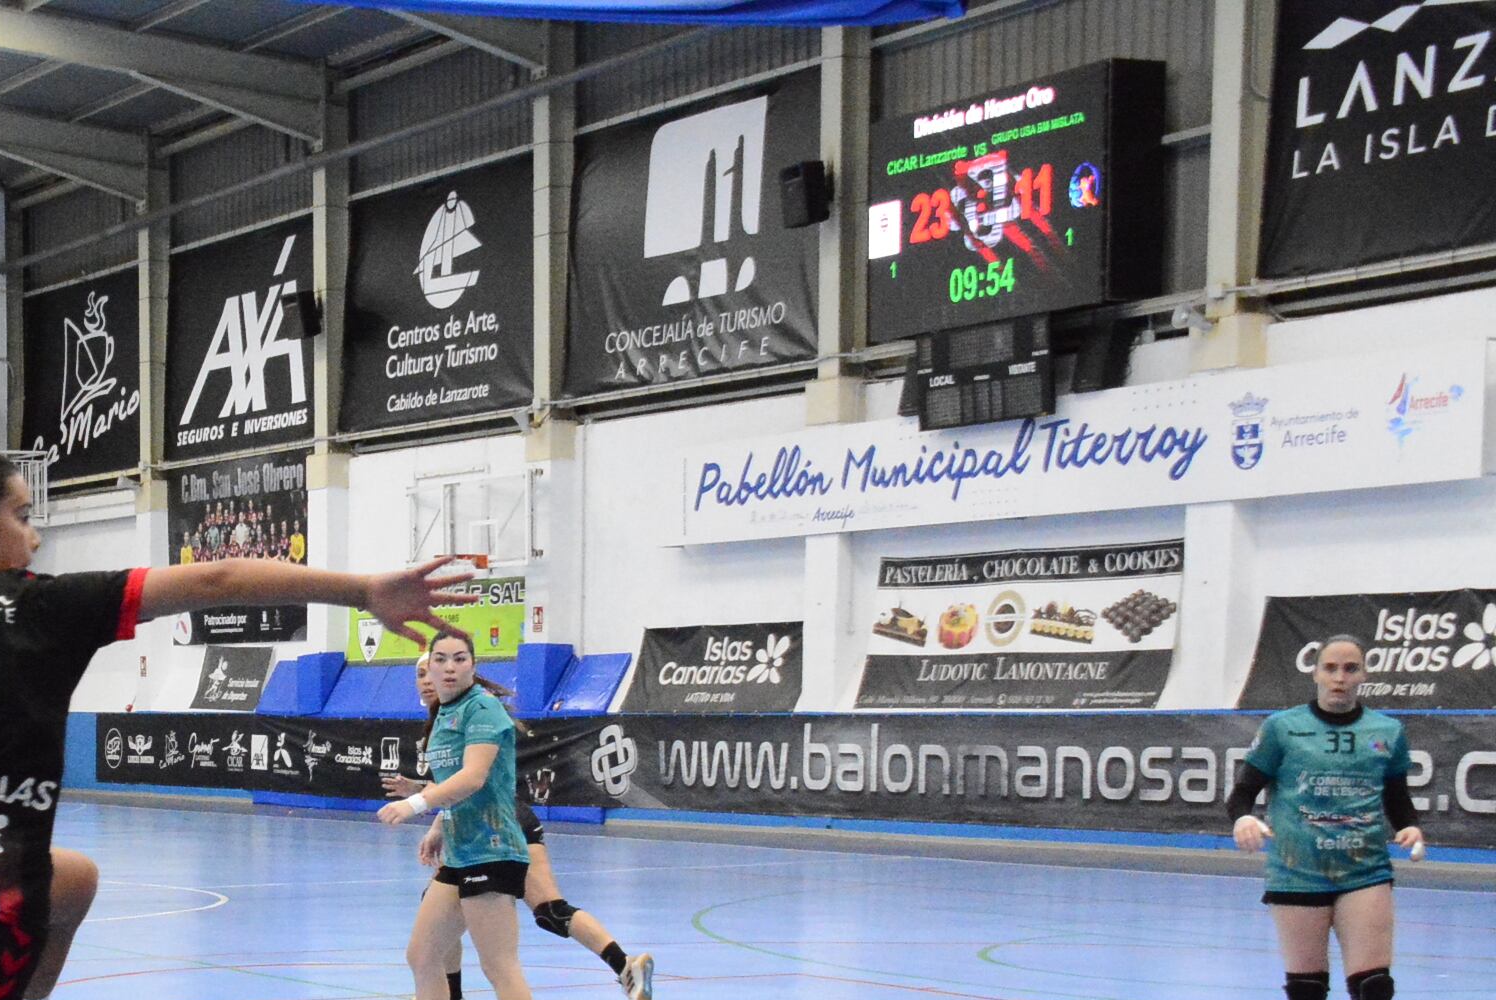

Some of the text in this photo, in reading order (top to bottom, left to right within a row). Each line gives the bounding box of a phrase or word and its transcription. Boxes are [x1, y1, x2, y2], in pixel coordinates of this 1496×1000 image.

[914, 86, 1055, 138] División de Honor Oro
[887, 156, 918, 175] CICAR
[919, 146, 968, 168] Lanzarote
[991, 128, 1018, 145] GRUPO
[1019, 124, 1036, 138] USA
[1292, 141, 1340, 180] LA
[1364, 115, 1461, 164] ISLA
[909, 163, 1053, 244] 23 11
[949, 257, 1015, 303] 09:54
[387, 310, 499, 349] Centros de Arte,
[605, 301, 786, 353] CONCEJALÍA de TURISMO
[386, 343, 498, 378] Cultura y Turismo
[615, 337, 769, 380] ARRECIFE
[387, 383, 489, 412] Cabildo de Lanzarote
[929, 374, 955, 388] LOCAL
[1270, 408, 1359, 428] Ayuntamiento de
[1410, 392, 1449, 410] Arrecife
[177, 408, 308, 447] SEGUROS E INVERSIONES
[1281, 424, 1347, 449] Arrecife
[212, 470, 231, 499] San
[234, 465, 260, 497] José
[263, 462, 304, 493] Obrero
[694, 444, 833, 511] Pabellón
[841, 417, 1036, 501] Municipal
[1039, 418, 1208, 481] Titerroy
[812, 505, 854, 528] Arrecife
[884, 558, 968, 584] PASTELERÍA
[983, 555, 1080, 579] CHOCOLATE
[1087, 558, 1099, 573] &
[1105, 548, 1180, 573] COOKIES
[1374, 607, 1457, 641] Islas
[704, 636, 753, 661] Islas
[658, 661, 747, 685] Canarias
[917, 656, 1109, 682] LUDOVIC LAMONTAGNE
[1392, 682, 1408, 696] DE
[1409, 682, 1436, 696] VIDA
[1325, 730, 1356, 754] 33
